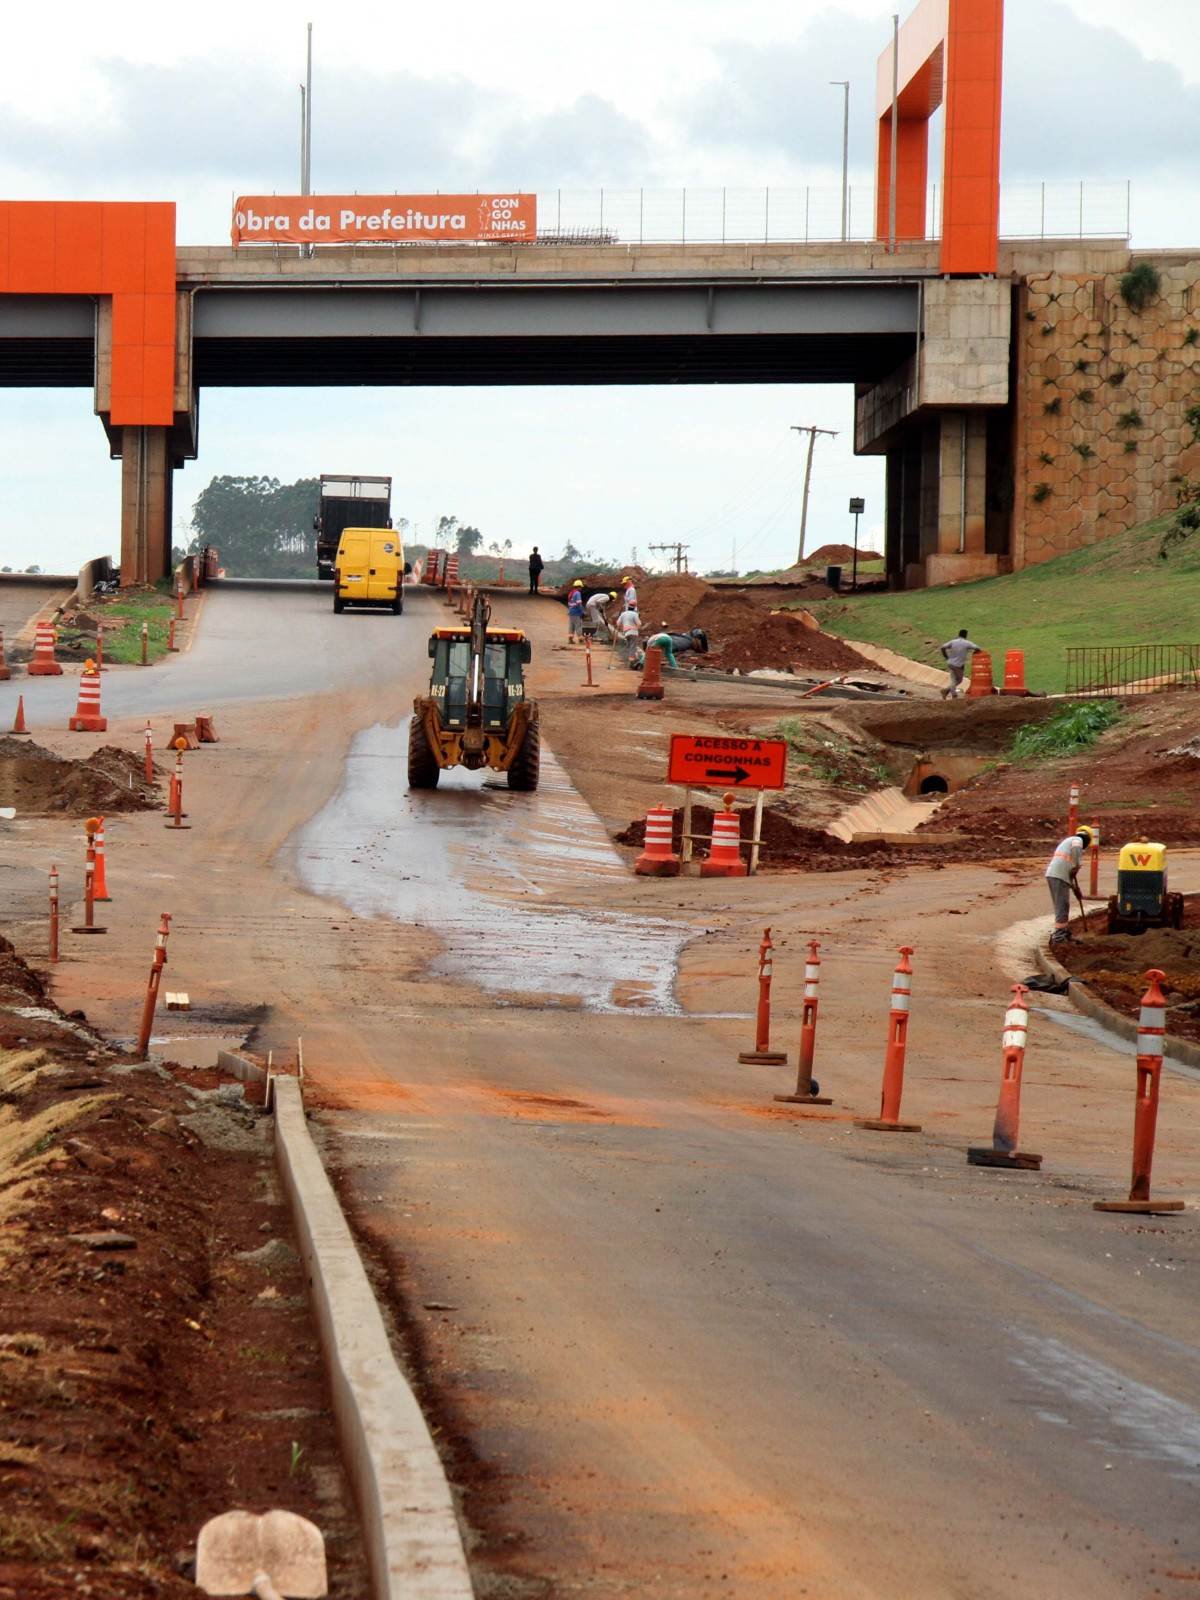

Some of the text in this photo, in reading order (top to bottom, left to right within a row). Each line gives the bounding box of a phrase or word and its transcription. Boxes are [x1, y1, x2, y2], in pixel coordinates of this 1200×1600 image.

[492, 198, 520, 209] CON
[236, 208, 466, 231] Obra da Prefeitura
[492, 209, 512, 220] GO
[492, 220, 527, 231] NHAS
[694, 738, 749, 751] ACESSO
[684, 752, 772, 767] CONGONHAS
